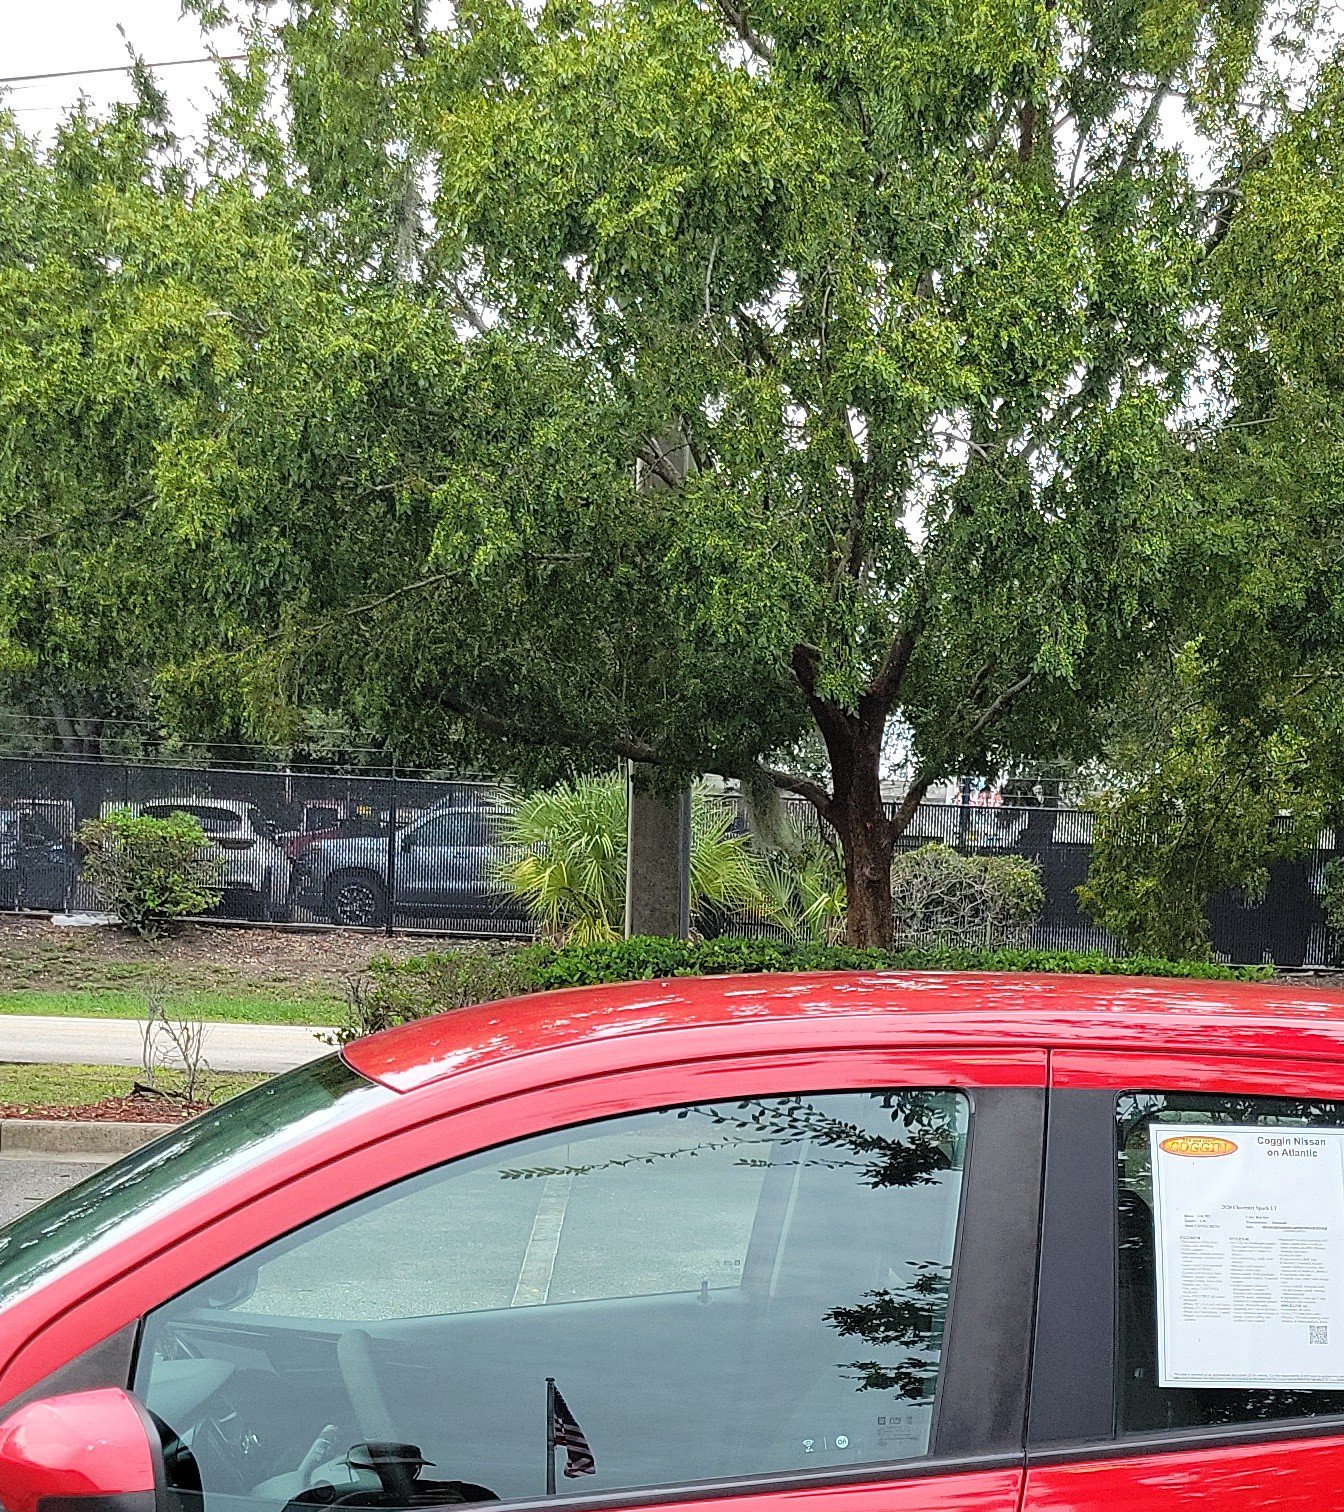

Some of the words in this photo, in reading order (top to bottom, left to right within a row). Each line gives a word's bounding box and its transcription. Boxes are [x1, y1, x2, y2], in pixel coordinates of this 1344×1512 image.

[1257, 1136, 1291, 1147] Coggin
[1294, 1137, 1326, 1146] Nissan
[1281, 1148, 1318, 1158] Atlantic
